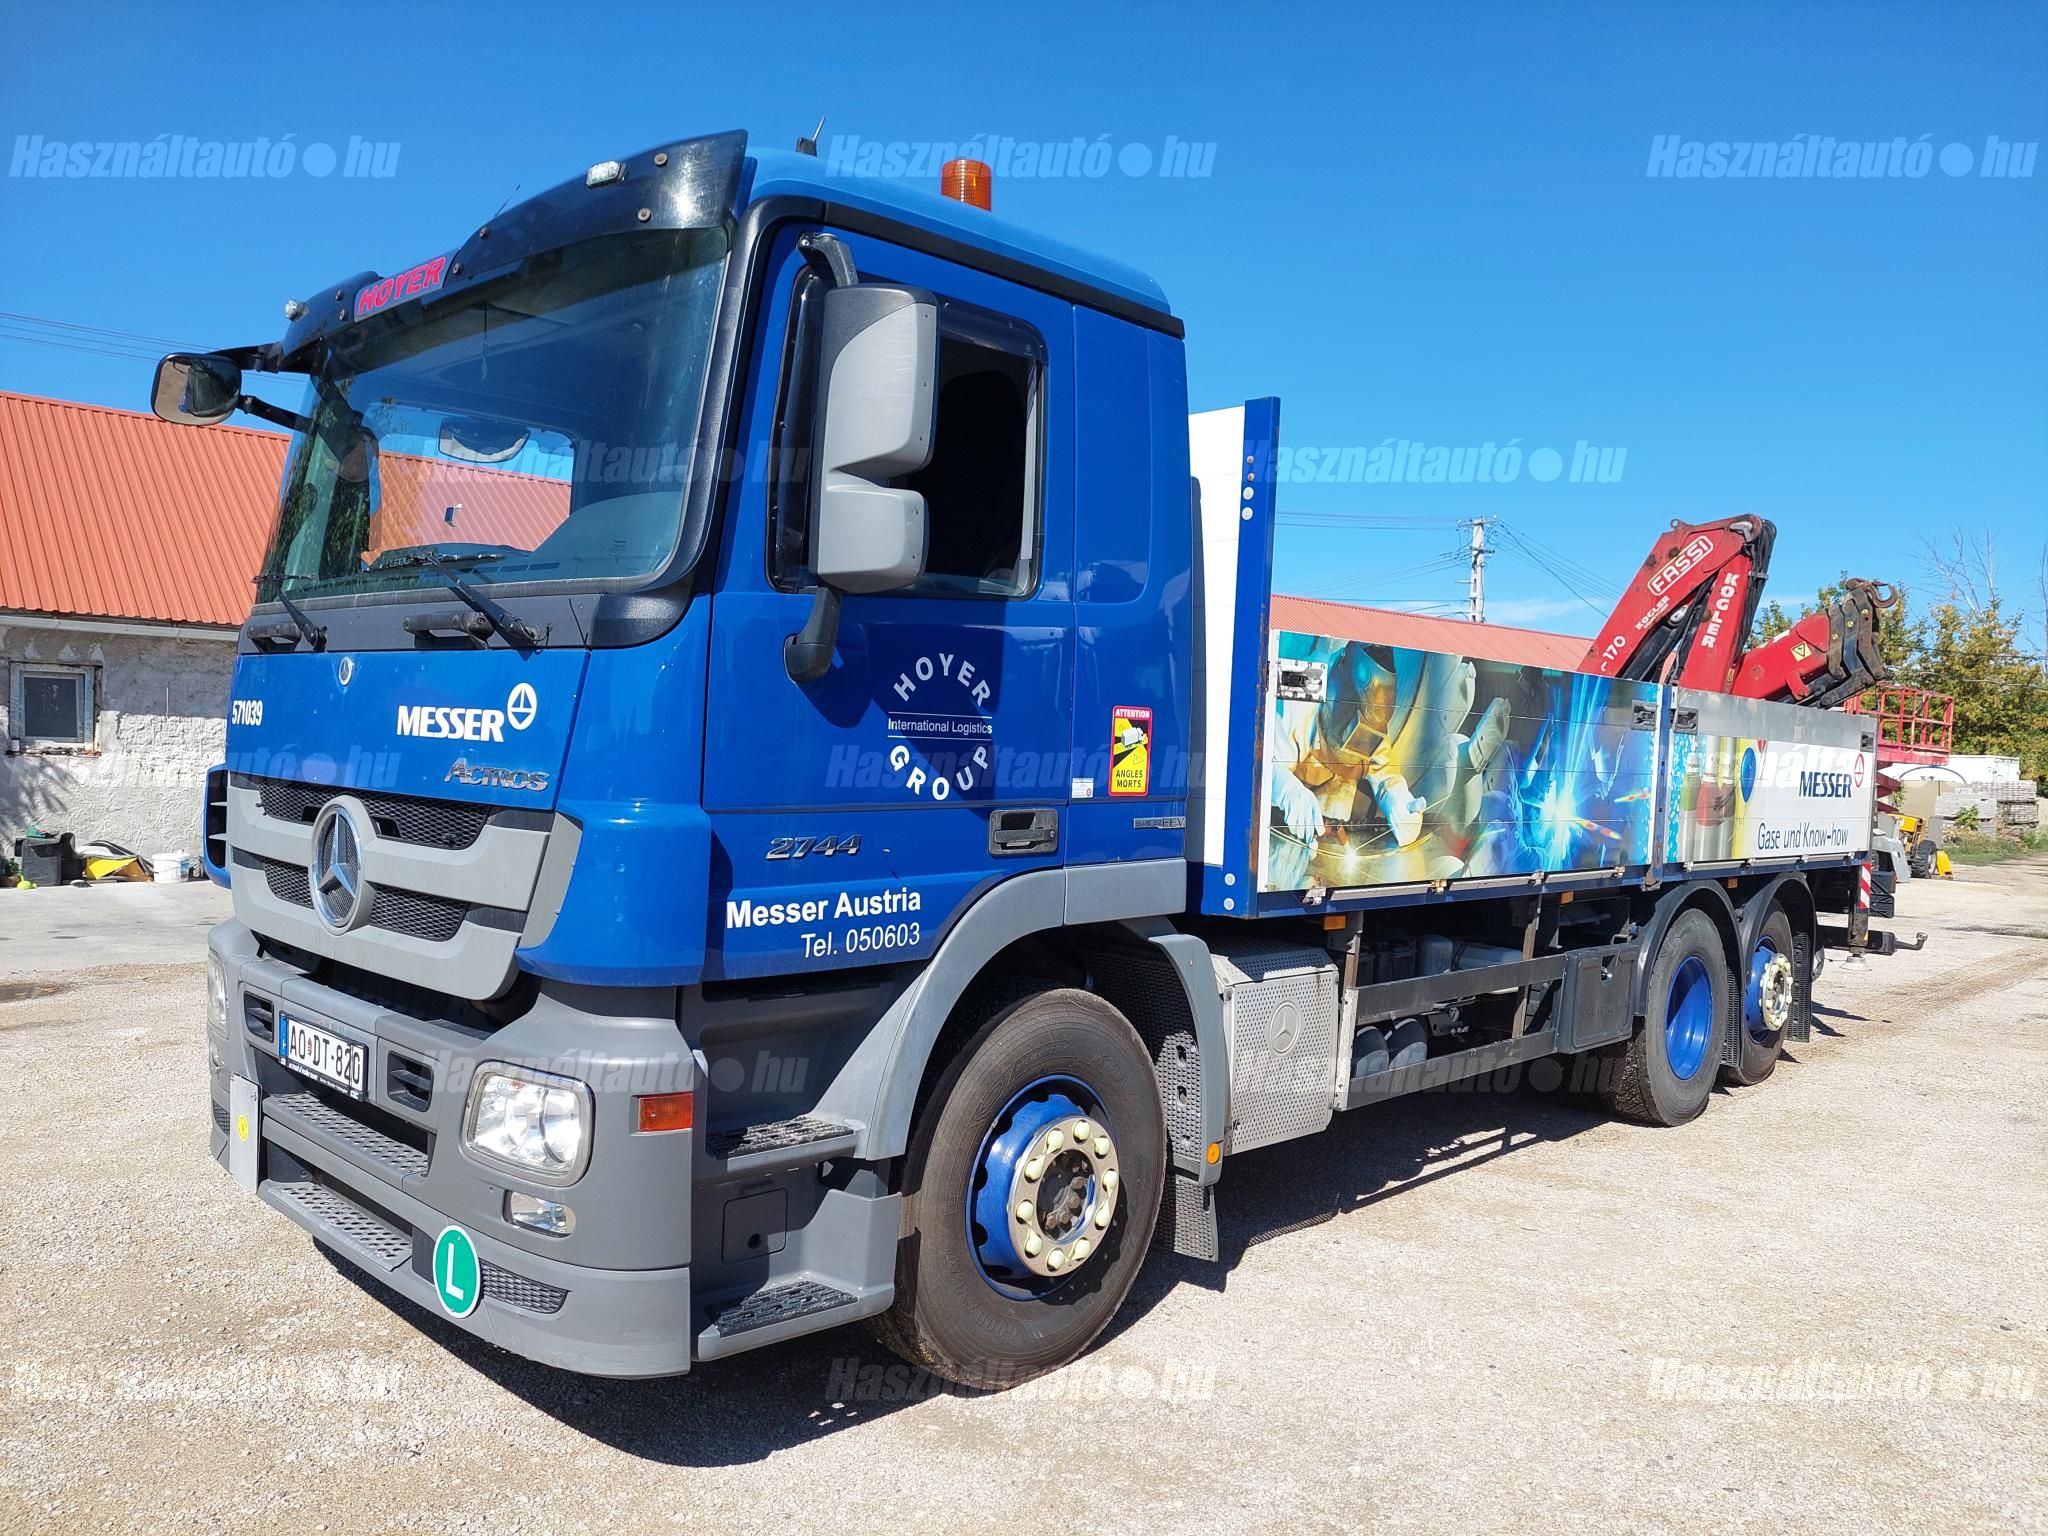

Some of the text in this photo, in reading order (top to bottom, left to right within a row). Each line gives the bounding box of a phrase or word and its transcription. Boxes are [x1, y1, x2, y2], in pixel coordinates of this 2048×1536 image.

[357, 257, 446, 316] HOYER
[1651, 540, 1710, 592] FASSI
[1701, 572, 1741, 649] KOGLER
[893, 653, 991, 707] HOYER
[231, 700, 263, 726] 571039
[396, 705, 505, 743] MESSER
[888, 718, 992, 736] International Logistics
[1115, 708, 1150, 719] ATTENTION
[890, 745, 989, 801] GROUP
[1116, 769, 1143, 778] ANGLES
[1116, 779, 1142, 788] MORTS
[1798, 770, 1852, 798] MESSER
[765, 834, 861, 859] 2744
[1757, 820, 1848, 850] Gase und Know-how
[726, 887, 921, 929] Messer Austria
[800, 922, 921, 959] Tel. 050603
[290, 1025, 306, 1060] AO
[445, 1242, 464, 1302] L
